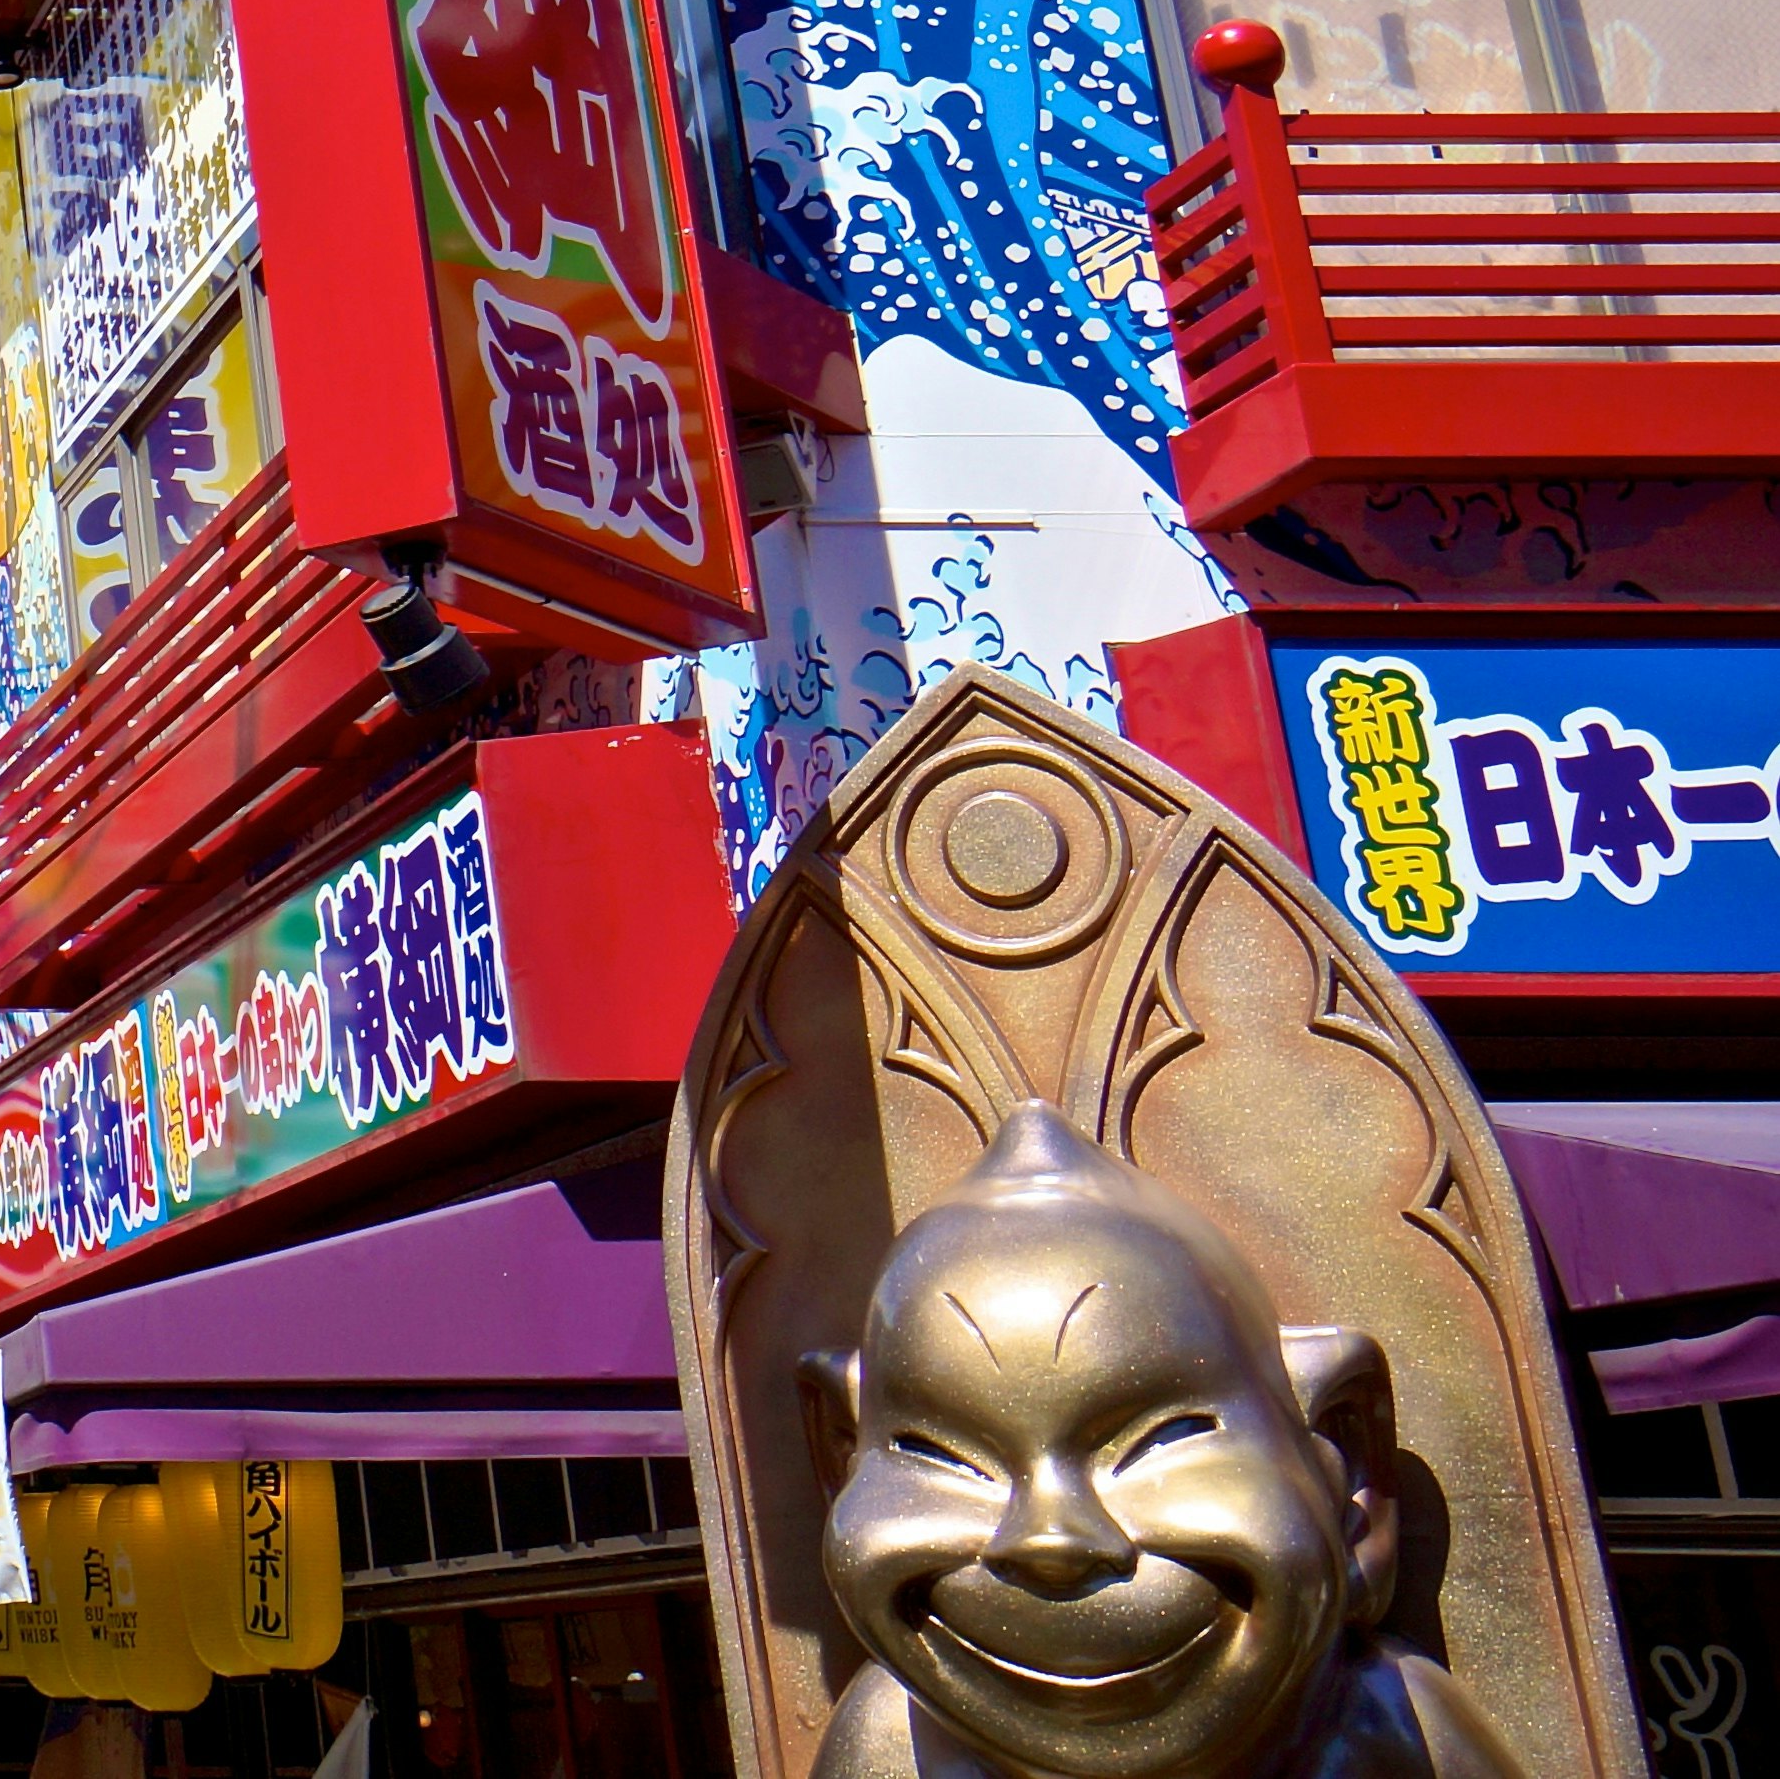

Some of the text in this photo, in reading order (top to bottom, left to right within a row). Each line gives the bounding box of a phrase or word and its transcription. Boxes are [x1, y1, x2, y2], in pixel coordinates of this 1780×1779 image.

[485, 295, 701, 553] 酒処
[1325, 666, 1464, 943] 新世界
[1448, 722, 1780, 889] 日本一
[319, 870, 465, 1123] 横綱
[443, 806, 509, 1059] 酒処
[41, 1035, 131, 1257] 横綱
[155, 995, 191, 1200] 新世界
[179, 979, 325, 1148] 日本一の串かつ
[243, 1460, 283, 1633] 角ハイボール
